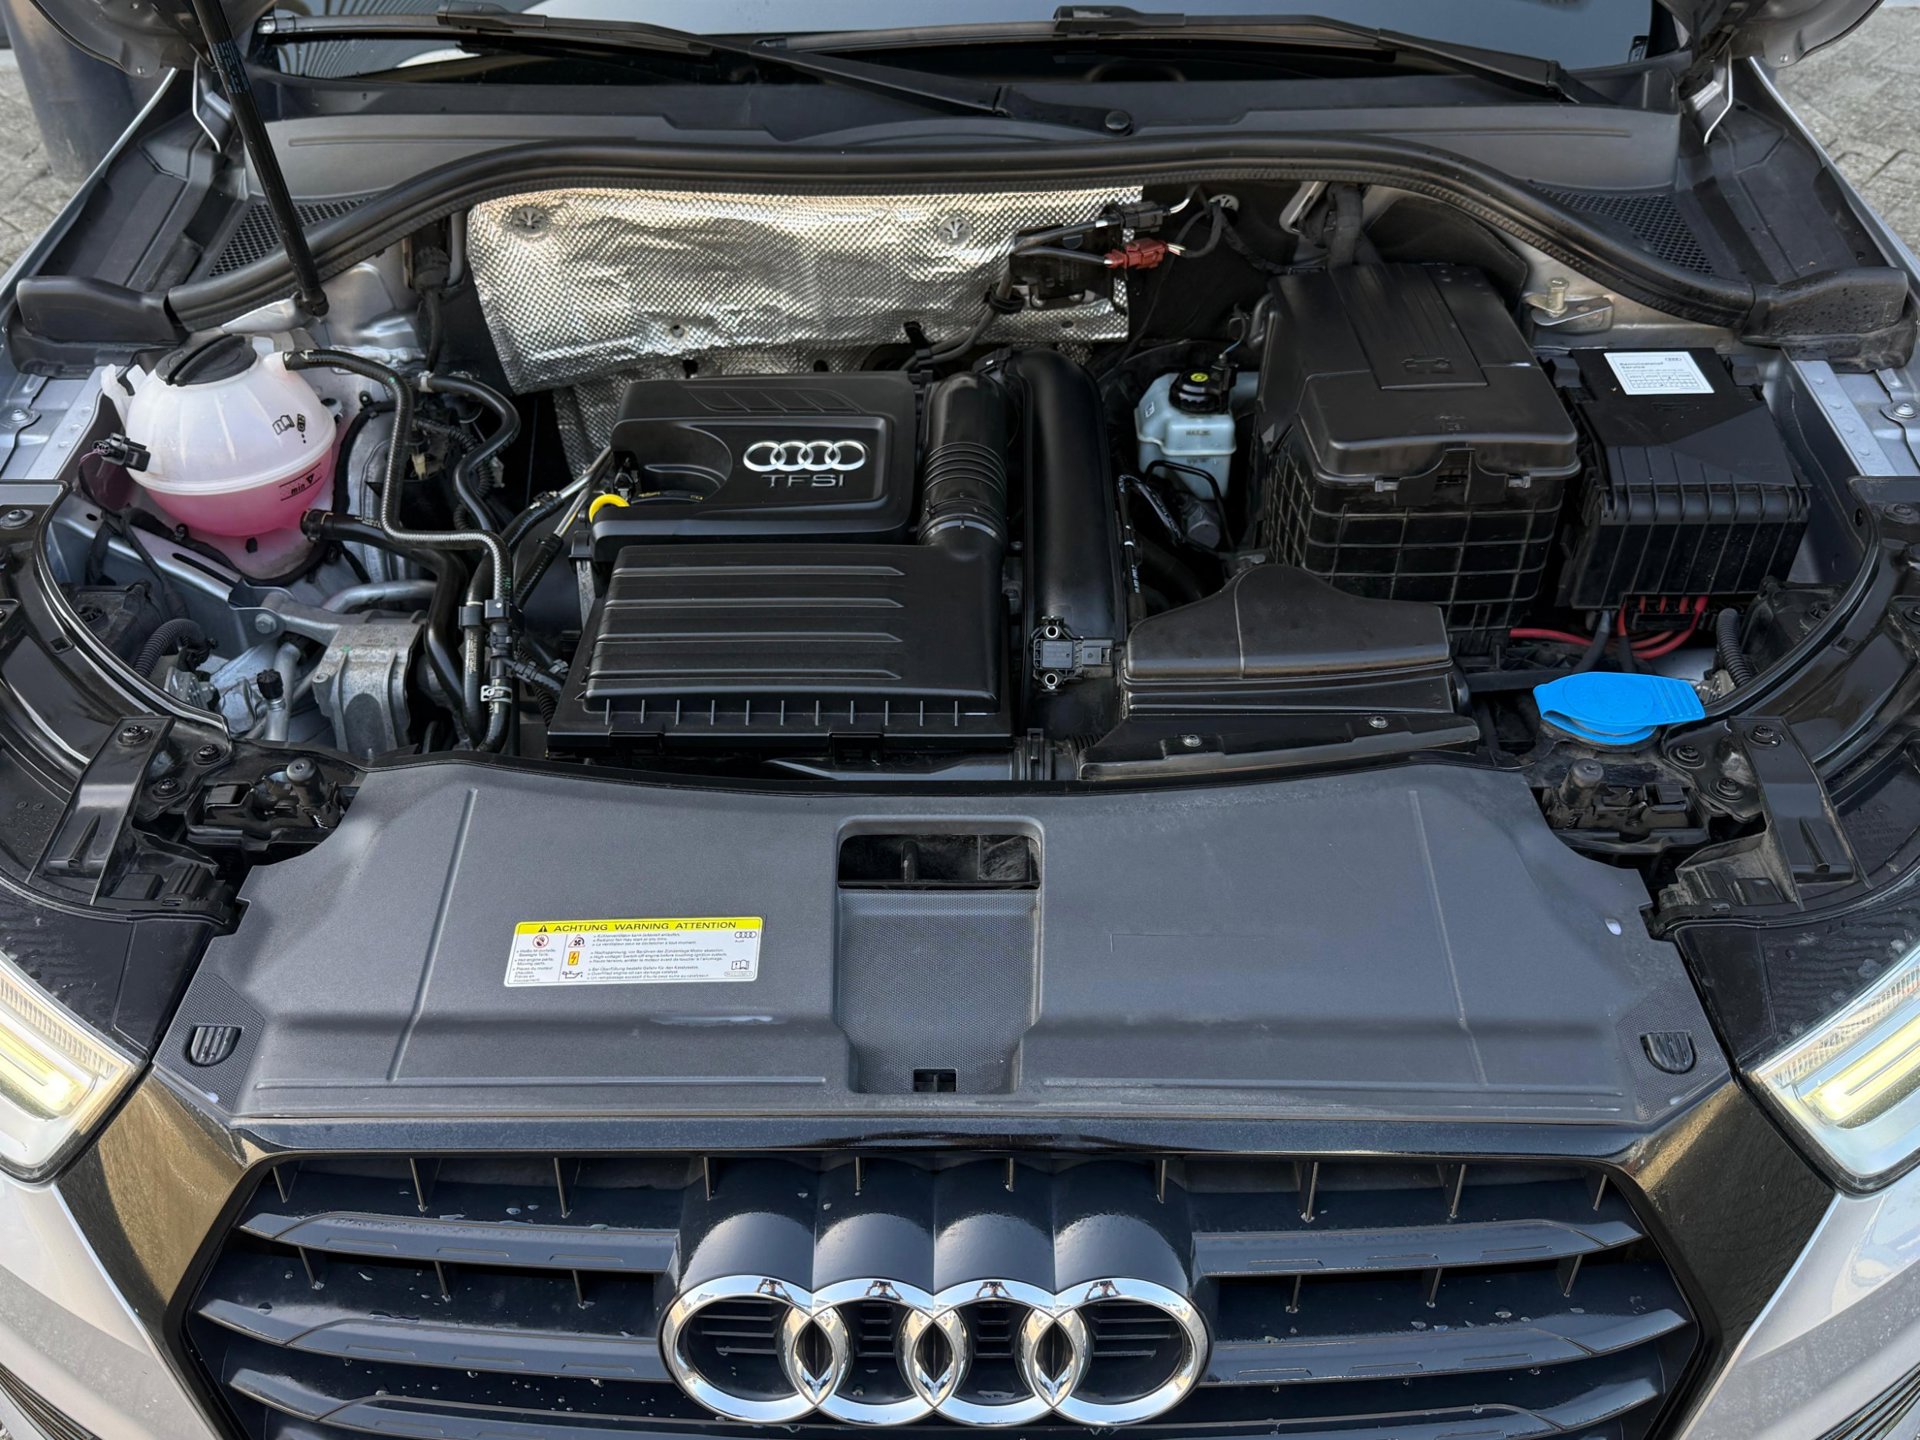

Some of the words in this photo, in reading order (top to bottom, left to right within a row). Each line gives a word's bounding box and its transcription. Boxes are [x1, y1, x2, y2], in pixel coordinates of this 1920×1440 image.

[760, 474, 844, 488] TFSI
[291, 483, 306, 495] min
[553, 924, 608, 932] ACHTUNG
[614, 922, 669, 930] WARNING
[675, 921, 737, 929] ATTENTION
